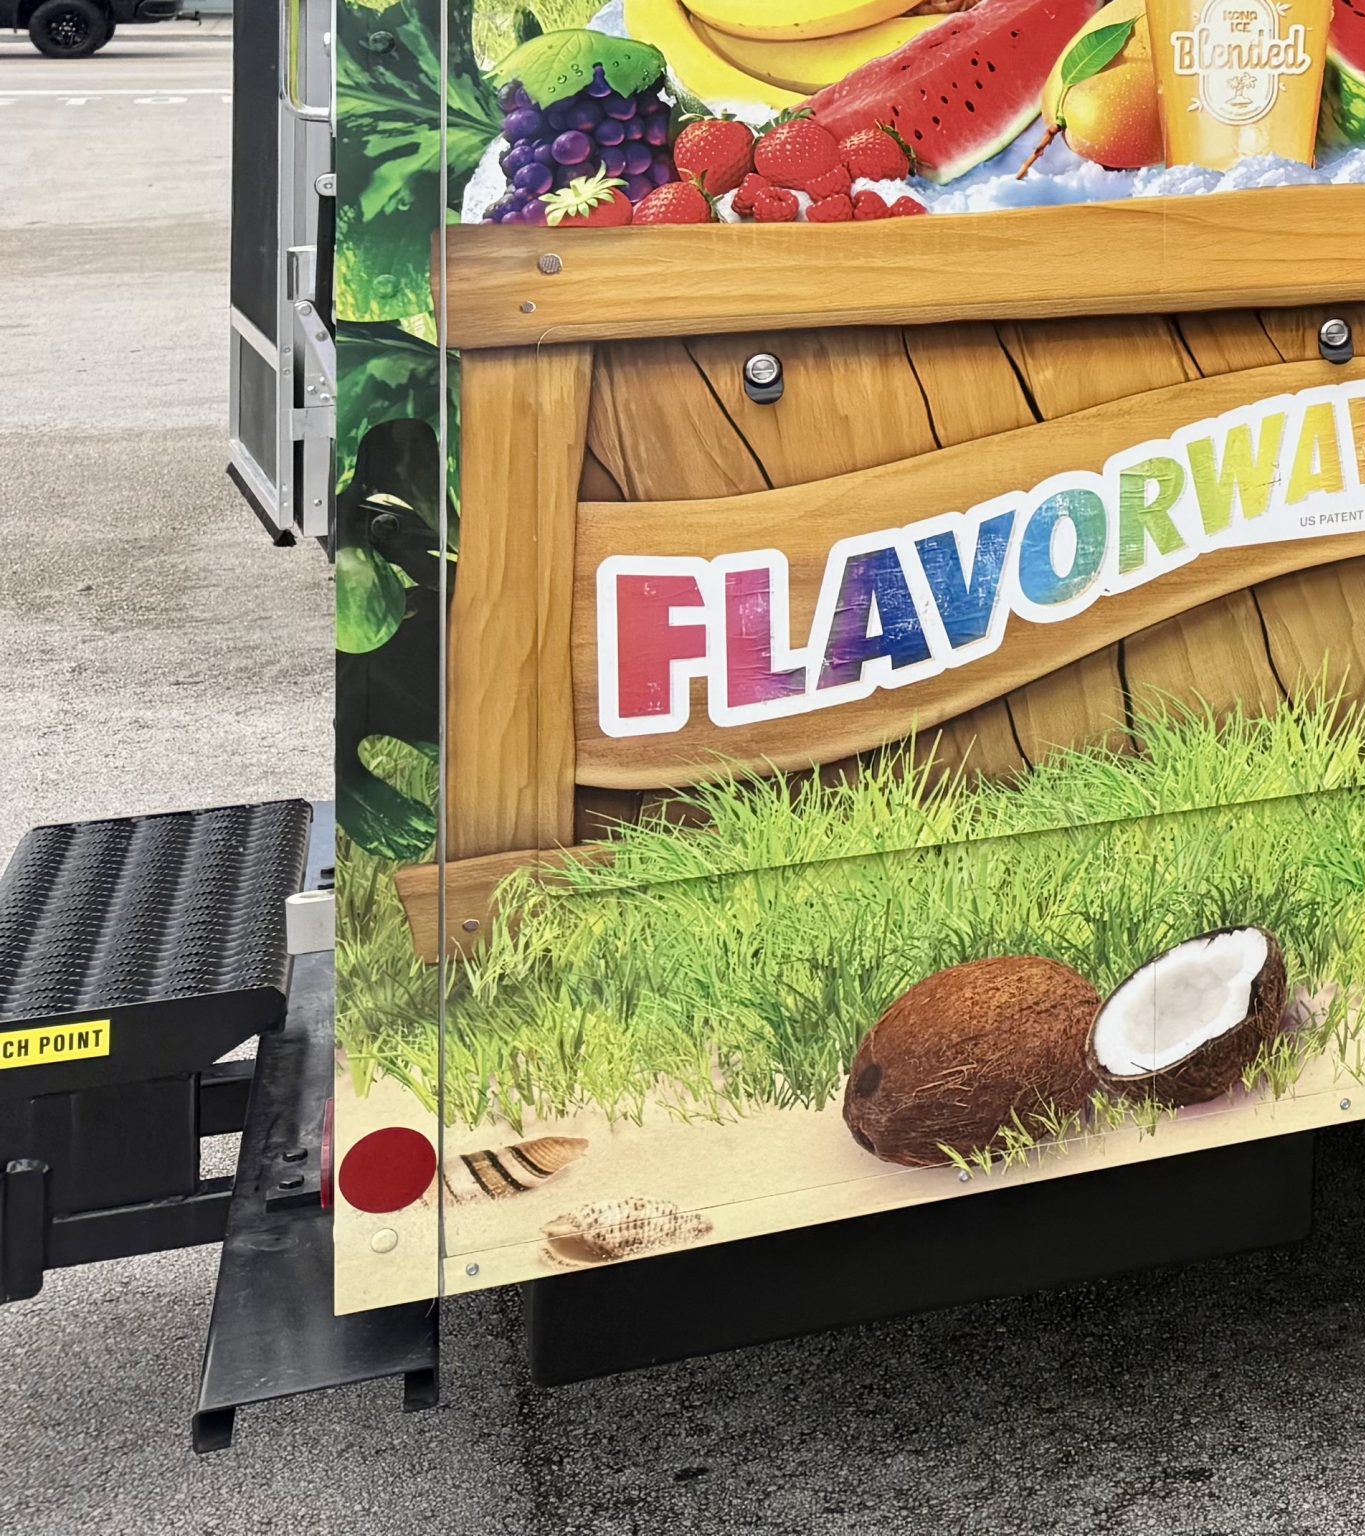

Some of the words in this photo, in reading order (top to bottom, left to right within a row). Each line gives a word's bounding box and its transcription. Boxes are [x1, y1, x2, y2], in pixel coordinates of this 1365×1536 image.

[1230, 22, 1252, 34] ICE
[1172, 26, 1308, 71] Blended
[1300, 516, 1315, 527] US
[1319, 510, 1363, 525] PATENT
[39, 1029, 103, 1055] POINT
